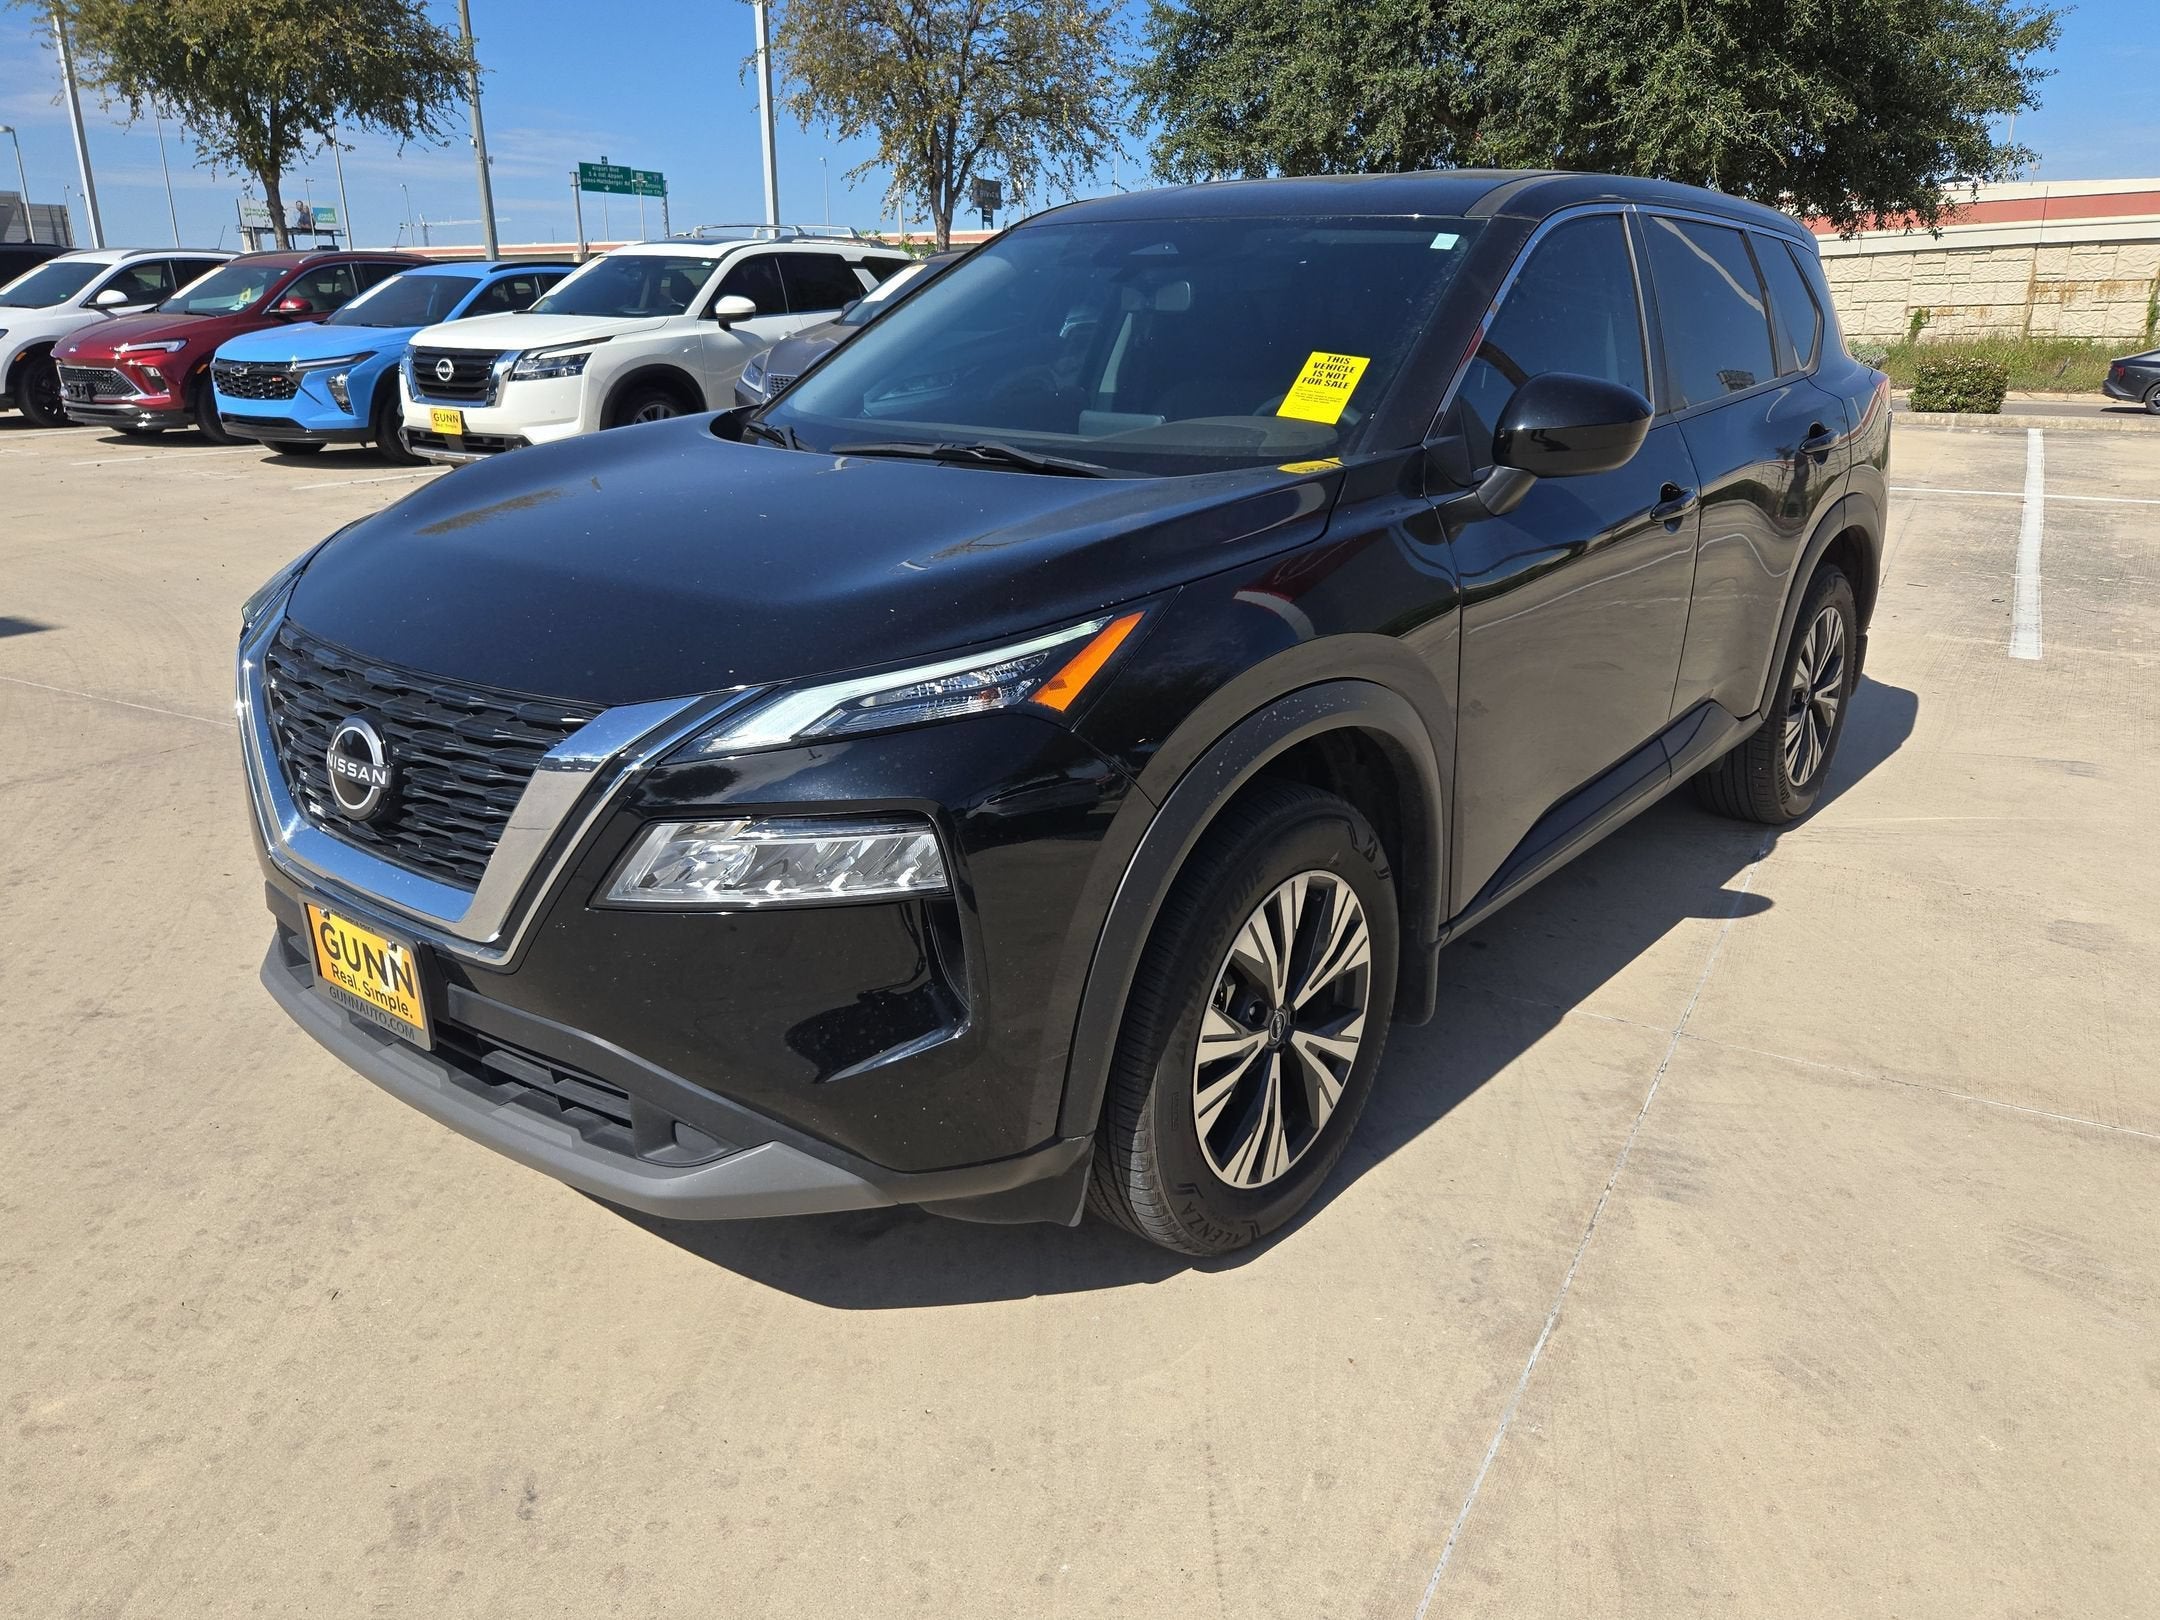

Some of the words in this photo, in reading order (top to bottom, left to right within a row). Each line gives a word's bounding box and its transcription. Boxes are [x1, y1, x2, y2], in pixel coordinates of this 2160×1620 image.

[1327, 355, 1351, 365] THIS
[1313, 362, 1356, 374] VEHICLE
[1312, 370, 1324, 378] IS
[1325, 371, 1348, 381] NOT
[1301, 376, 1321, 386] FOR
[1323, 380, 1350, 390] SALE
[433, 412, 459, 423] GUNN
[327, 750, 387, 785] NISSAN
[319, 921, 415, 999] GUNN
[331, 962, 361, 992] Real.
[362, 980, 414, 1019] Simple.
[329, 986, 416, 1041] GUNNAUTO.COM
